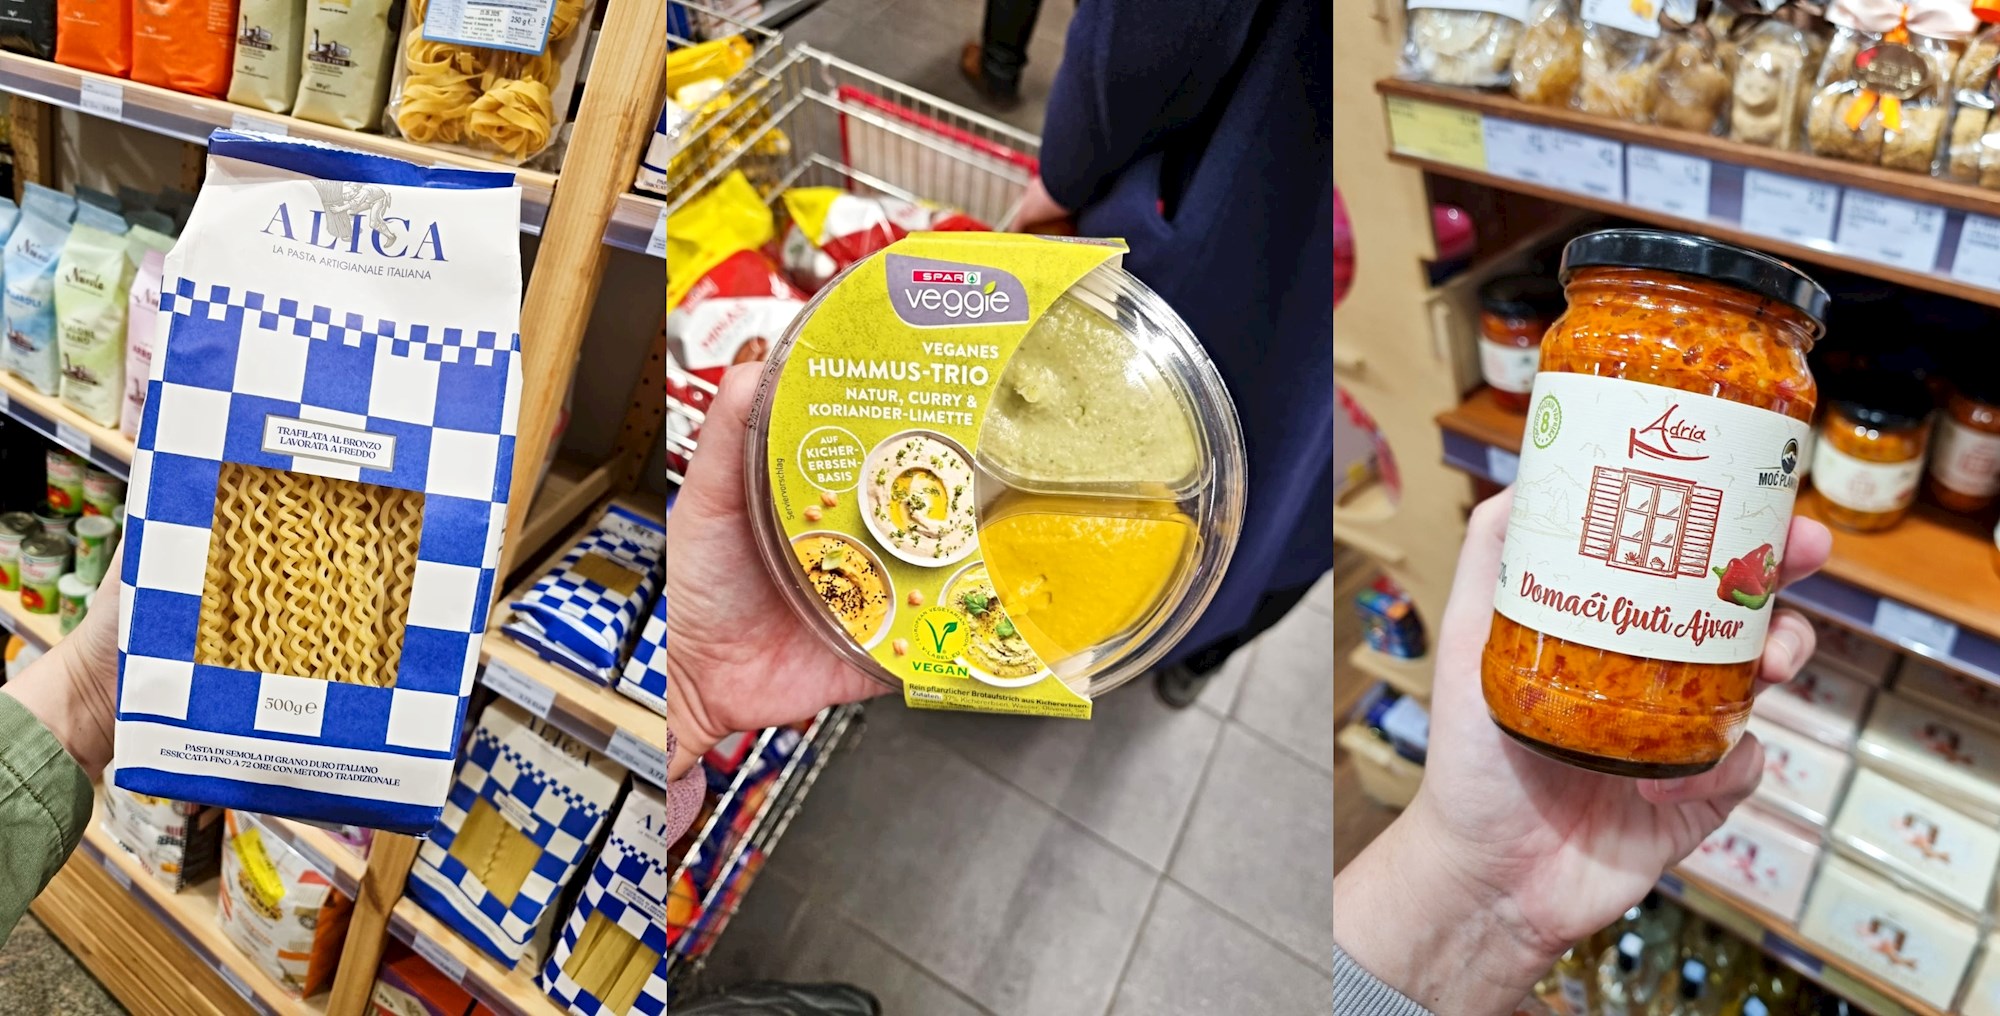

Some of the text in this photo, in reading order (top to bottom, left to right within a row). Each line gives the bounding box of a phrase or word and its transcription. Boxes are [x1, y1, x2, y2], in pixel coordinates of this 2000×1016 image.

[260, 202, 449, 262] ALICA
[272, 244, 432, 280] LA PASTA ARTIGIANALE ITALIANA
[922, 273, 964, 282] SPAR
[904, 288, 1010, 318] veggie
[921, 341, 999, 359] VEGANES
[808, 358, 989, 386] HUMMUS-TRIO
[845, 387, 978, 408] NATUR, CURRY &
[808, 403, 973, 426] KORIANDER-LIMETTE
[1540, 411, 1550, 433] 8
[277, 425, 382, 451] TRAFILATA AL BRONZO
[820, 435, 839, 444] AUF
[1640, 404, 1706, 453] Adria
[280, 436, 376, 460] LAVORATA A FREDDO
[805, 445, 859, 459] KICHER-
[807, 458, 862, 471] ERBSEN-
[816, 471, 853, 483] BASIS
[1758, 470, 1780, 486] MOĆ
[775, 457, 795, 521] Serviervorschlag
[1520, 570, 1744, 647] Domaći ljuti Ajvar
[913, 611, 928, 642] EUROPEAN
[929, 606, 966, 626] VEGETARIAN
[912, 661, 968, 676] VEGAN
[909, 683, 926, 692] Rein
[926, 685, 971, 697] pflanzlicher
[971, 691, 1020, 703] Brotaufstrich
[911, 691, 942, 700] Zutaten:
[264, 697, 303, 715] 500g
[160, 748, 400, 787] ESSICCATA FINO A 72 ORE CON METODO TRADIZIONALE
[185, 743, 378, 774] PASTA DI SEMOLA DI GRANO DURO ITALIANO
